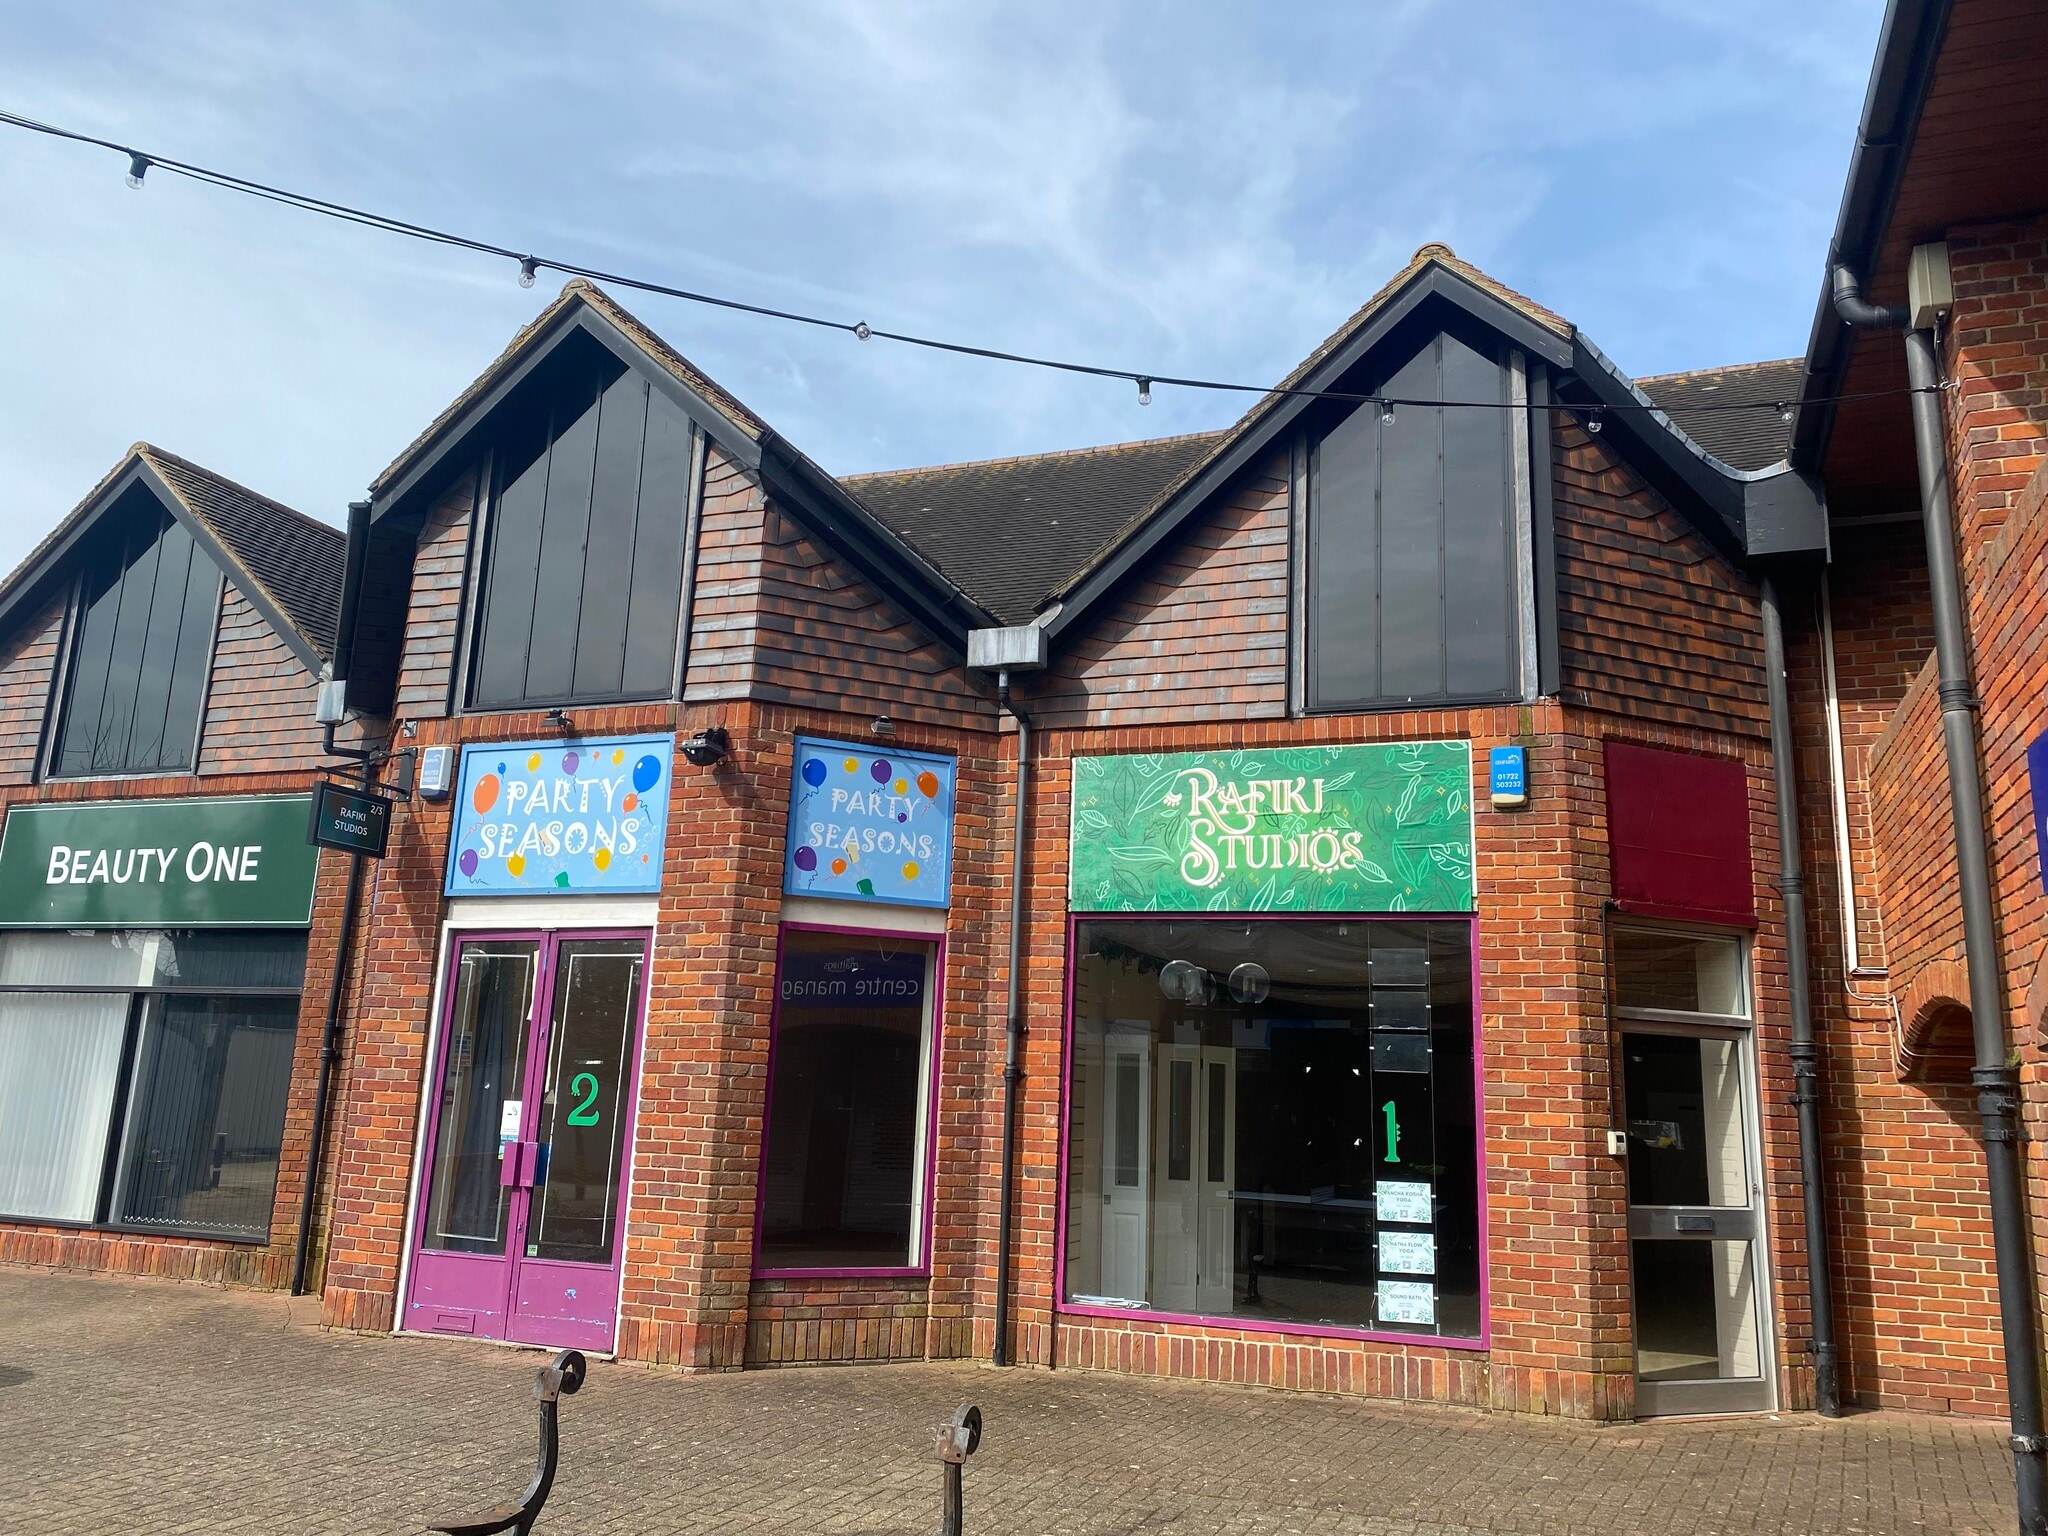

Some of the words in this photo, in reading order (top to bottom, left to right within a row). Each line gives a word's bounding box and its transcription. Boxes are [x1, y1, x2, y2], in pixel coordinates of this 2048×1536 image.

[506, 774, 626, 816] PARTY
[1495, 781, 1521, 789] 503232
[1497, 773, 1519, 781] 01722
[340, 806, 367, 822] RAFIKI
[370, 804, 383, 816] 2/3
[831, 788, 922, 822] PARTY
[1163, 767, 1326, 835] RAFIKI
[334, 819, 368, 836] STUDIOS
[478, 816, 640, 860] SEASONS
[808, 821, 934, 860] SEASONS
[46, 845, 178, 885] BEAUTY
[185, 841, 262, 883] ONE
[1180, 817, 1365, 890] STUDIOS
[567, 1072, 600, 1127] 2
[1382, 1101, 1401, 1163] 1
